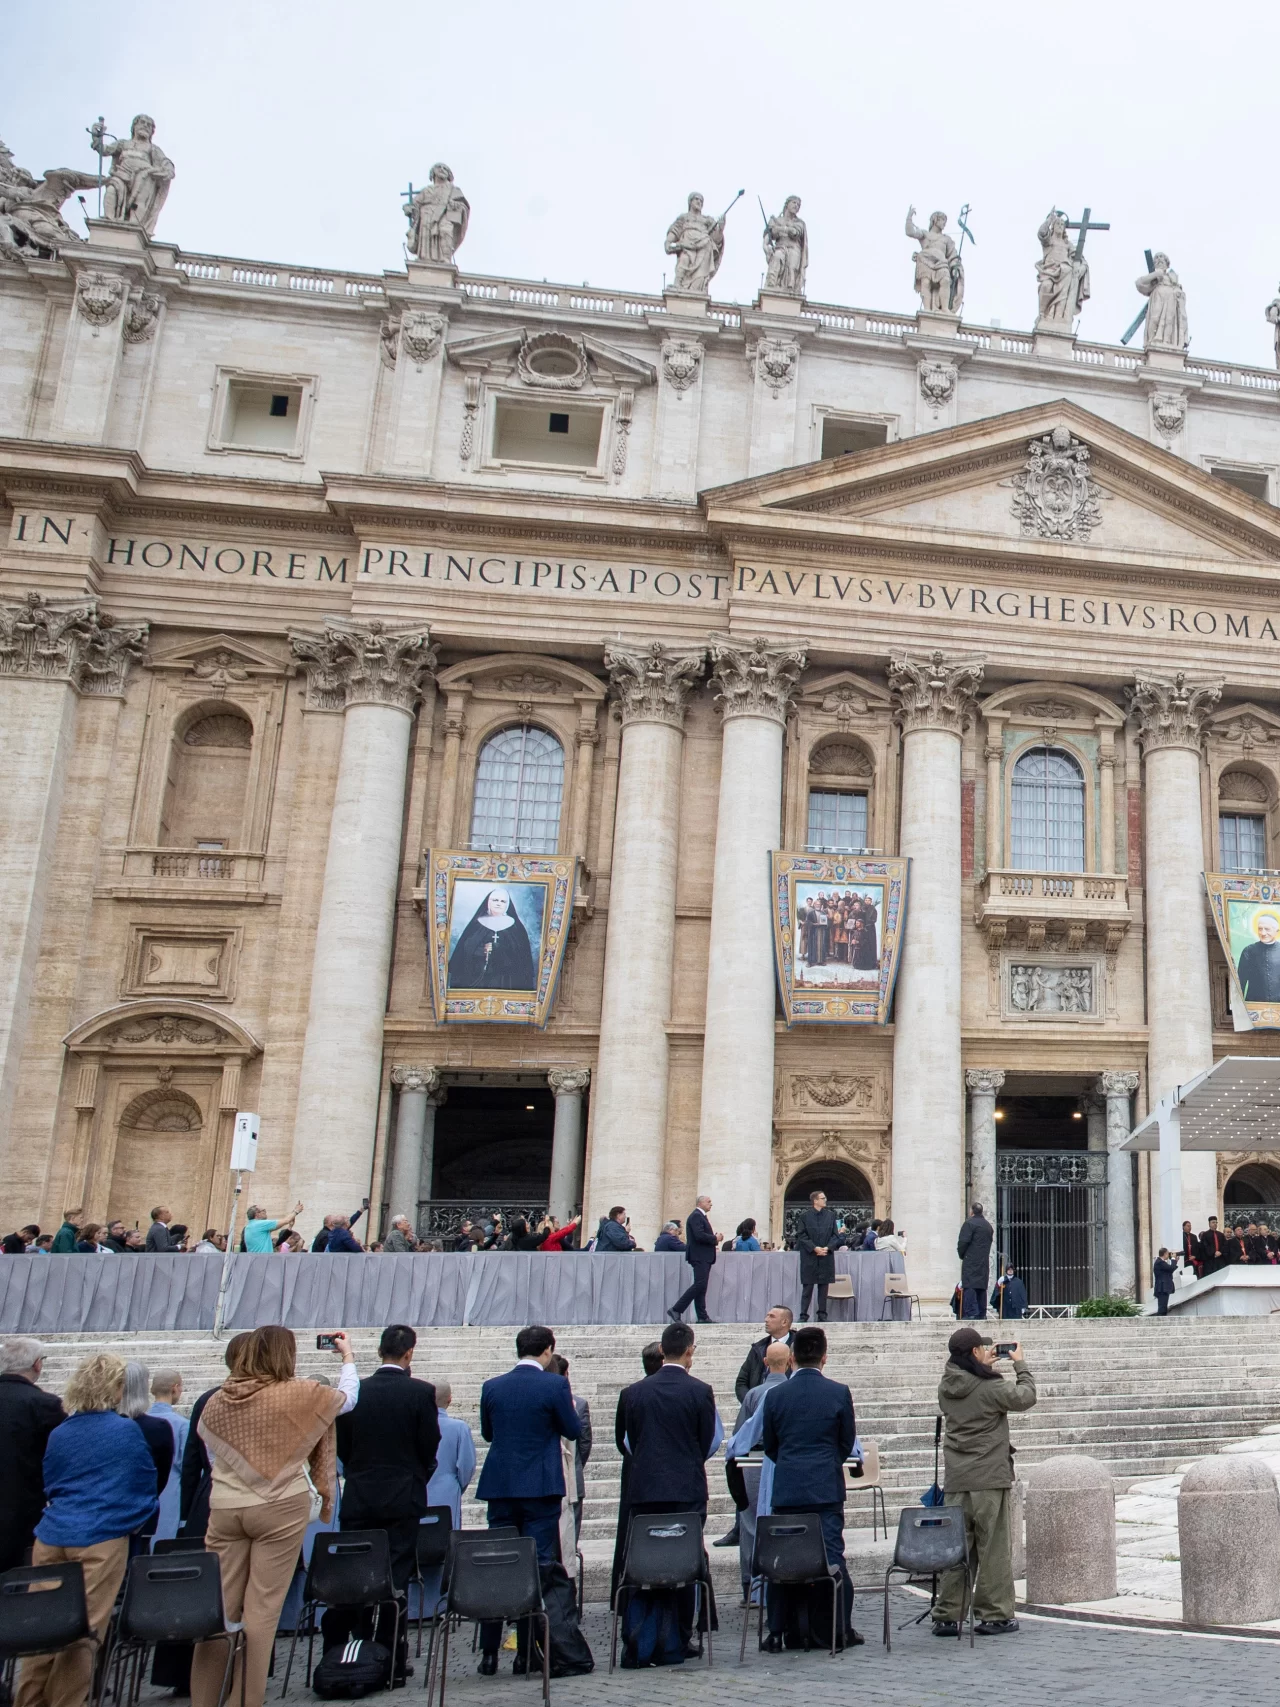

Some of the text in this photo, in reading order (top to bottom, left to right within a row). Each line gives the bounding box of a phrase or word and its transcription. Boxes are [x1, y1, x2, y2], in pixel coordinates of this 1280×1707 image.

[14, 514, 76, 545] IN
[104, 538, 350, 583] HONOREM
[362, 548, 587, 590] PRINCIPIS
[595, 568, 729, 600] APOST
[737, 566, 873, 603] PAVLVS
[882, 580, 905, 605] V
[917, 583, 1155, 629] BVRGHESIVS
